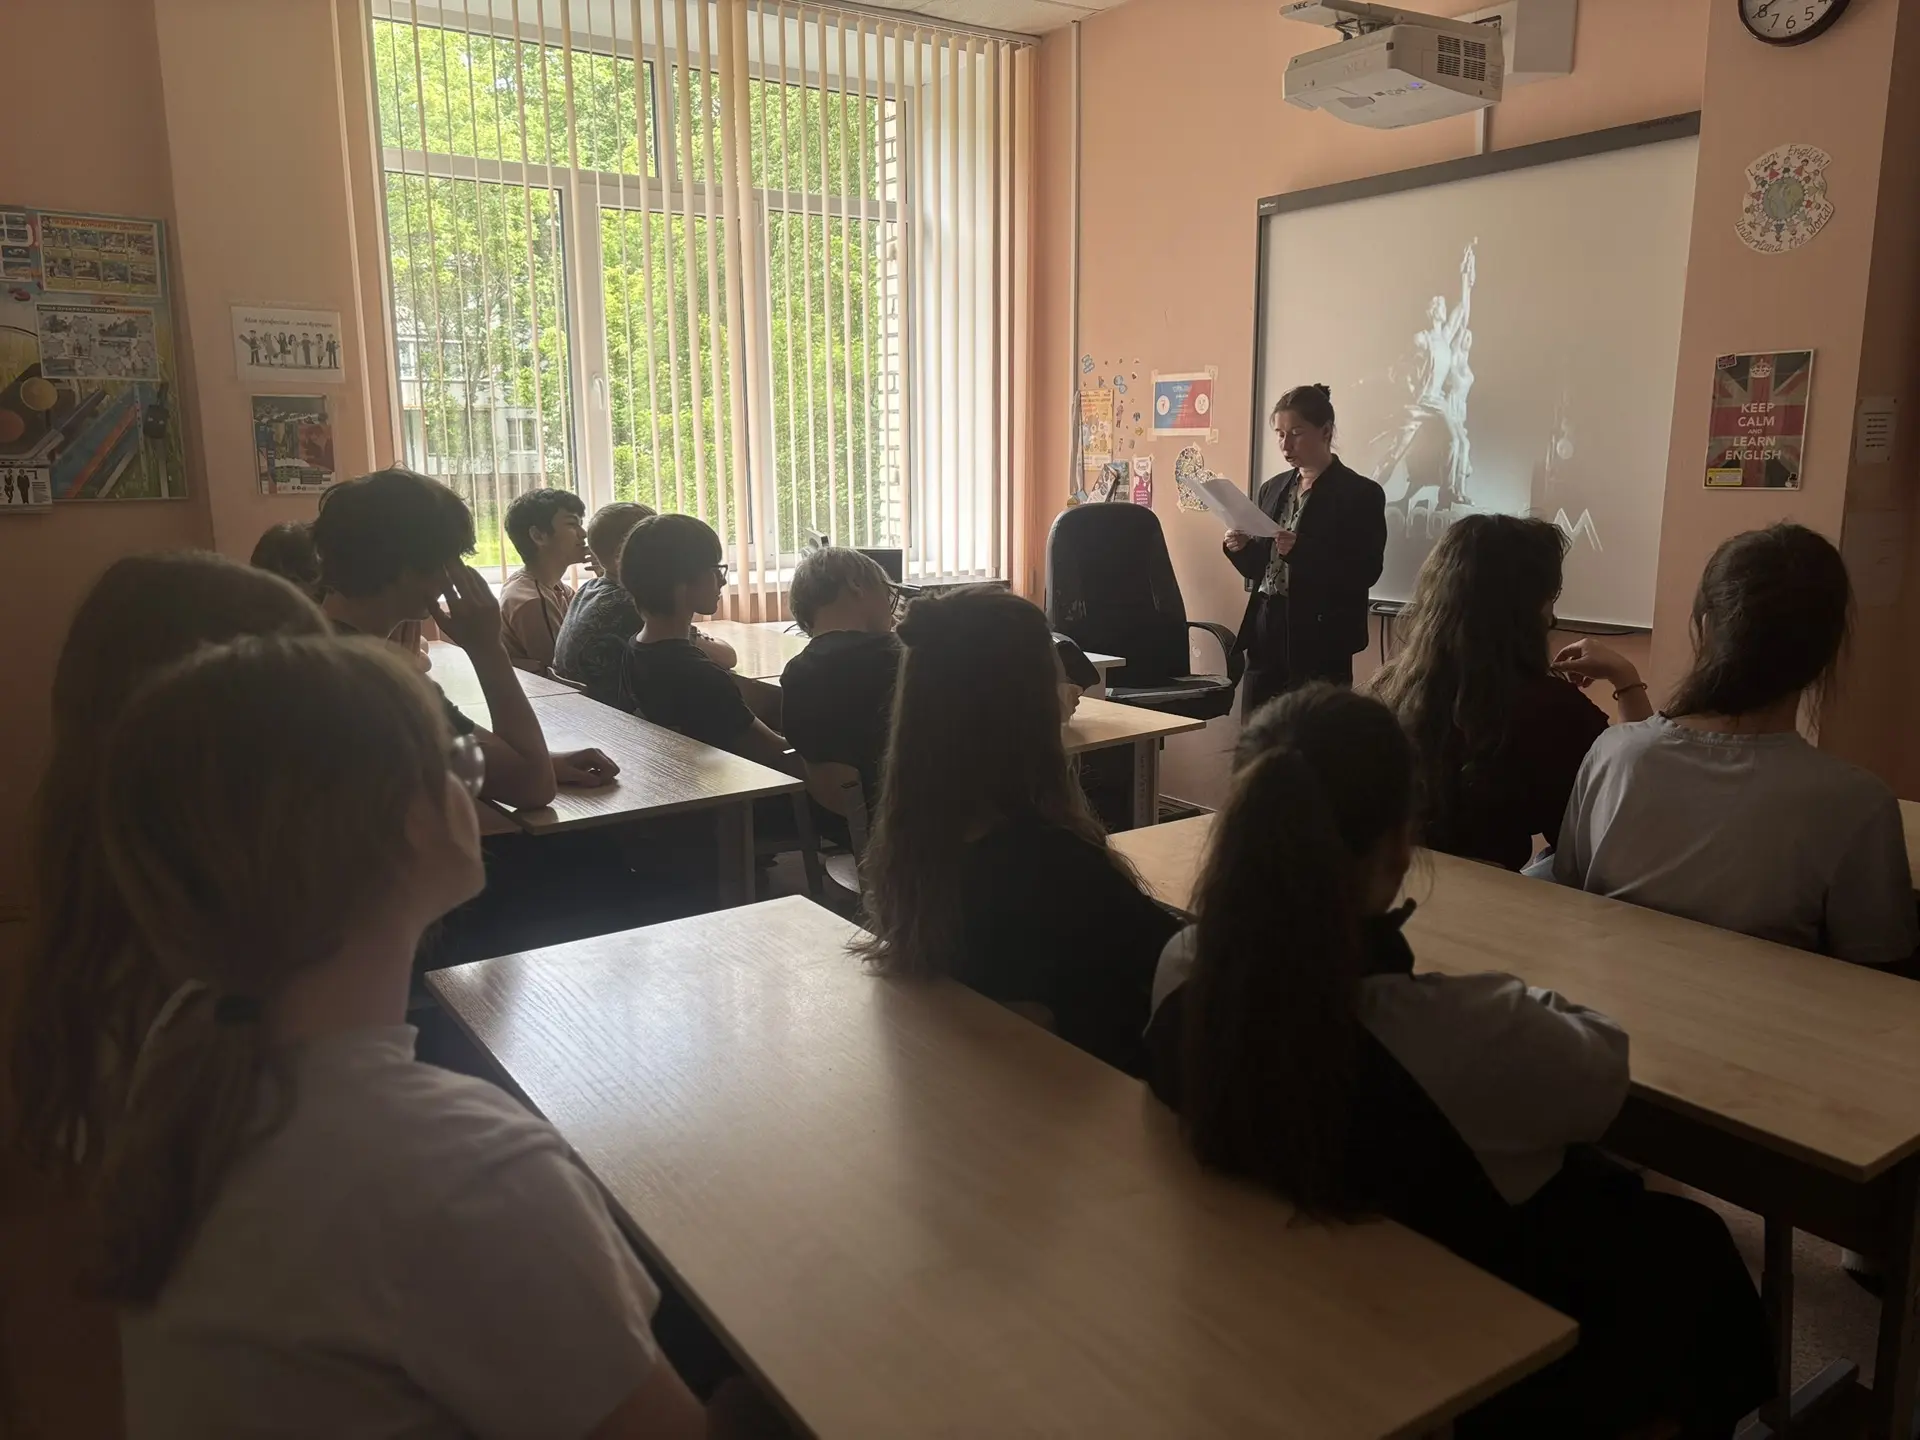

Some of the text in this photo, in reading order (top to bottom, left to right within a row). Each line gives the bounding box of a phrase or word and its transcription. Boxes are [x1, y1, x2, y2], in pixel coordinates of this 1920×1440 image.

[1292, 2, 1309, 12] NEC
[1757, 4, 1768, 19] 8
[1804, 5, 1815, 21] 5
[1771, 13, 1780, 28] 7
[1785, 15, 1796, 29] 6
[1747, 144, 1830, 177] Learn English!
[1788, 233, 1808, 250] the
[1806, 203, 1831, 236] World!
[1740, 402, 1776, 414] KEEP
[1737, 415, 1776, 427] CALM
[1732, 436, 1776, 447] LEARN
[1724, 449, 1782, 461] ENGLISH
